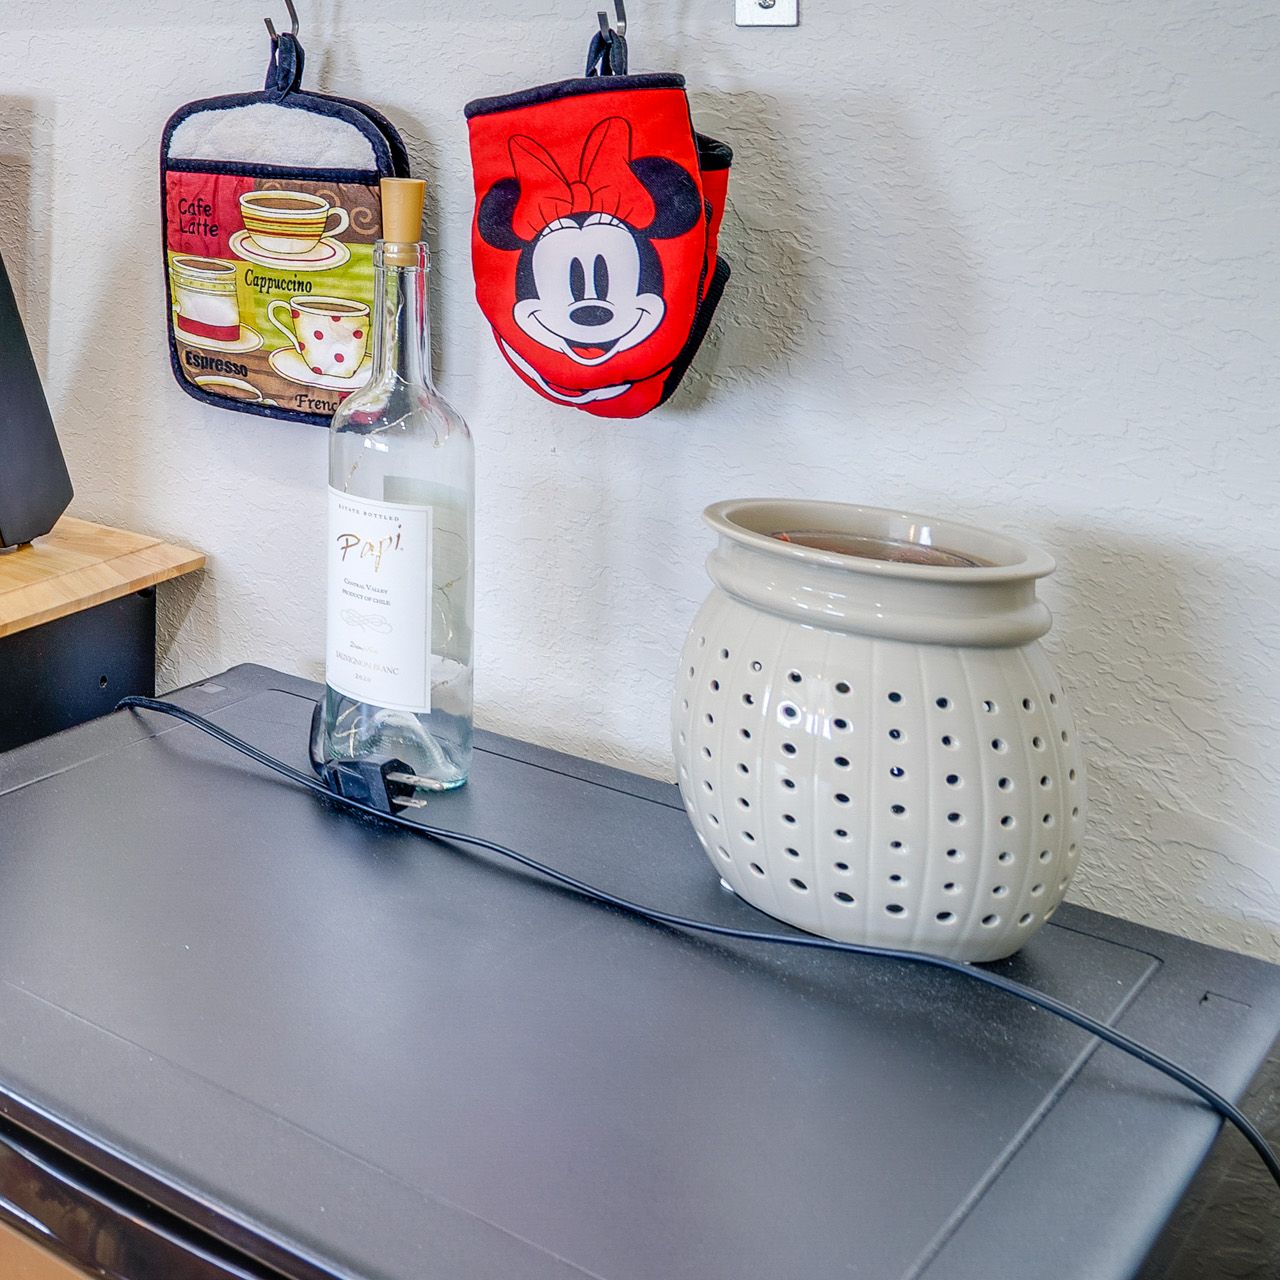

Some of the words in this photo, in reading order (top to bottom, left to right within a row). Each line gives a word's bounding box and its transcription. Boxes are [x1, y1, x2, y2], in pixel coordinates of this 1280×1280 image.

[178, 198, 213, 218] Cafe
[179, 219, 219, 238] Latte
[244, 268, 313, 294] Cappuccino
[185, 350, 249, 378] Espresso
[295, 393, 341, 412] Frenc
